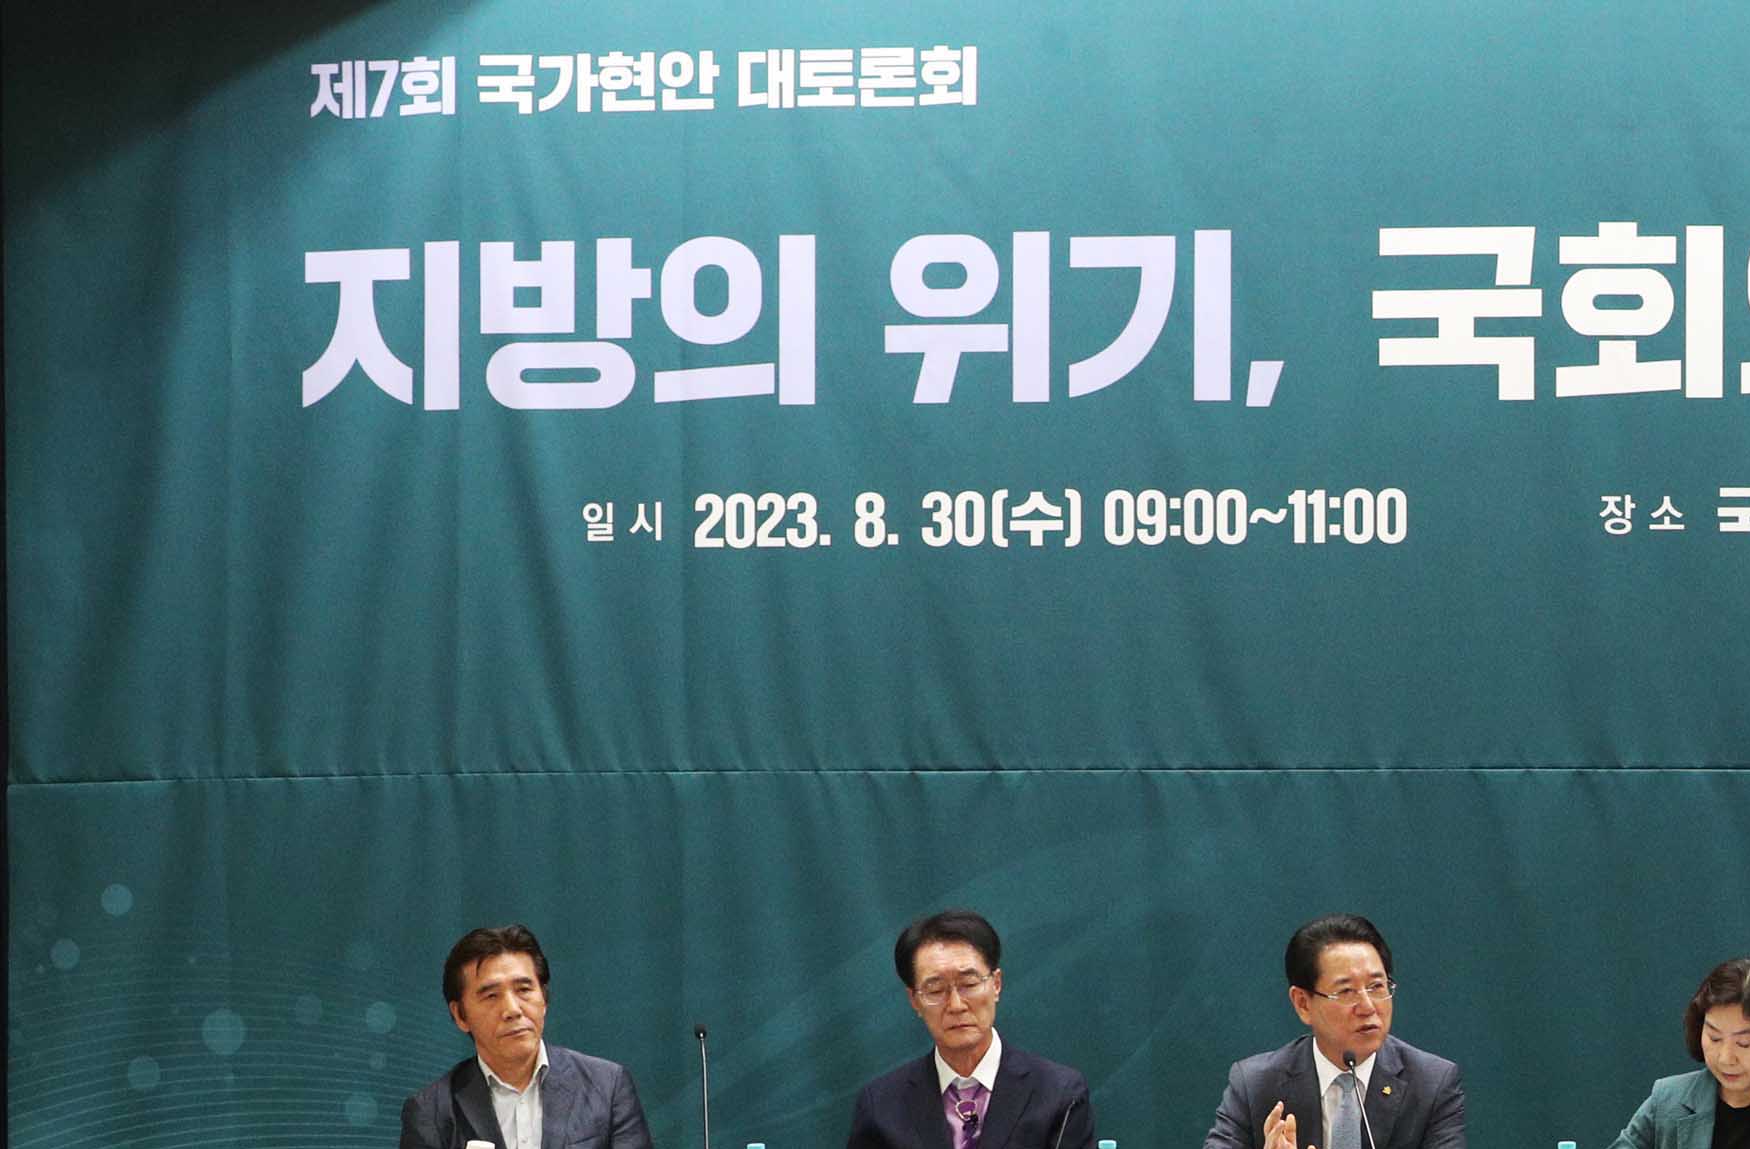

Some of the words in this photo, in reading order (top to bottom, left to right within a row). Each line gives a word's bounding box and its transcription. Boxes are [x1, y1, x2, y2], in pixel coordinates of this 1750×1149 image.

[310, 56, 456, 119] 제7회
[476, 51, 721, 115] 국가현안
[737, 45, 978, 109] 대토론회
[301, 234, 817, 411] 지방의
[884, 229, 1285, 407] 위기,
[694, 492, 831, 549] 2023.
[854, 491, 899, 548] 8.
[921, 488, 1082, 548] 30(수)
[1104, 487, 1408, 546] 09:00~11:00
